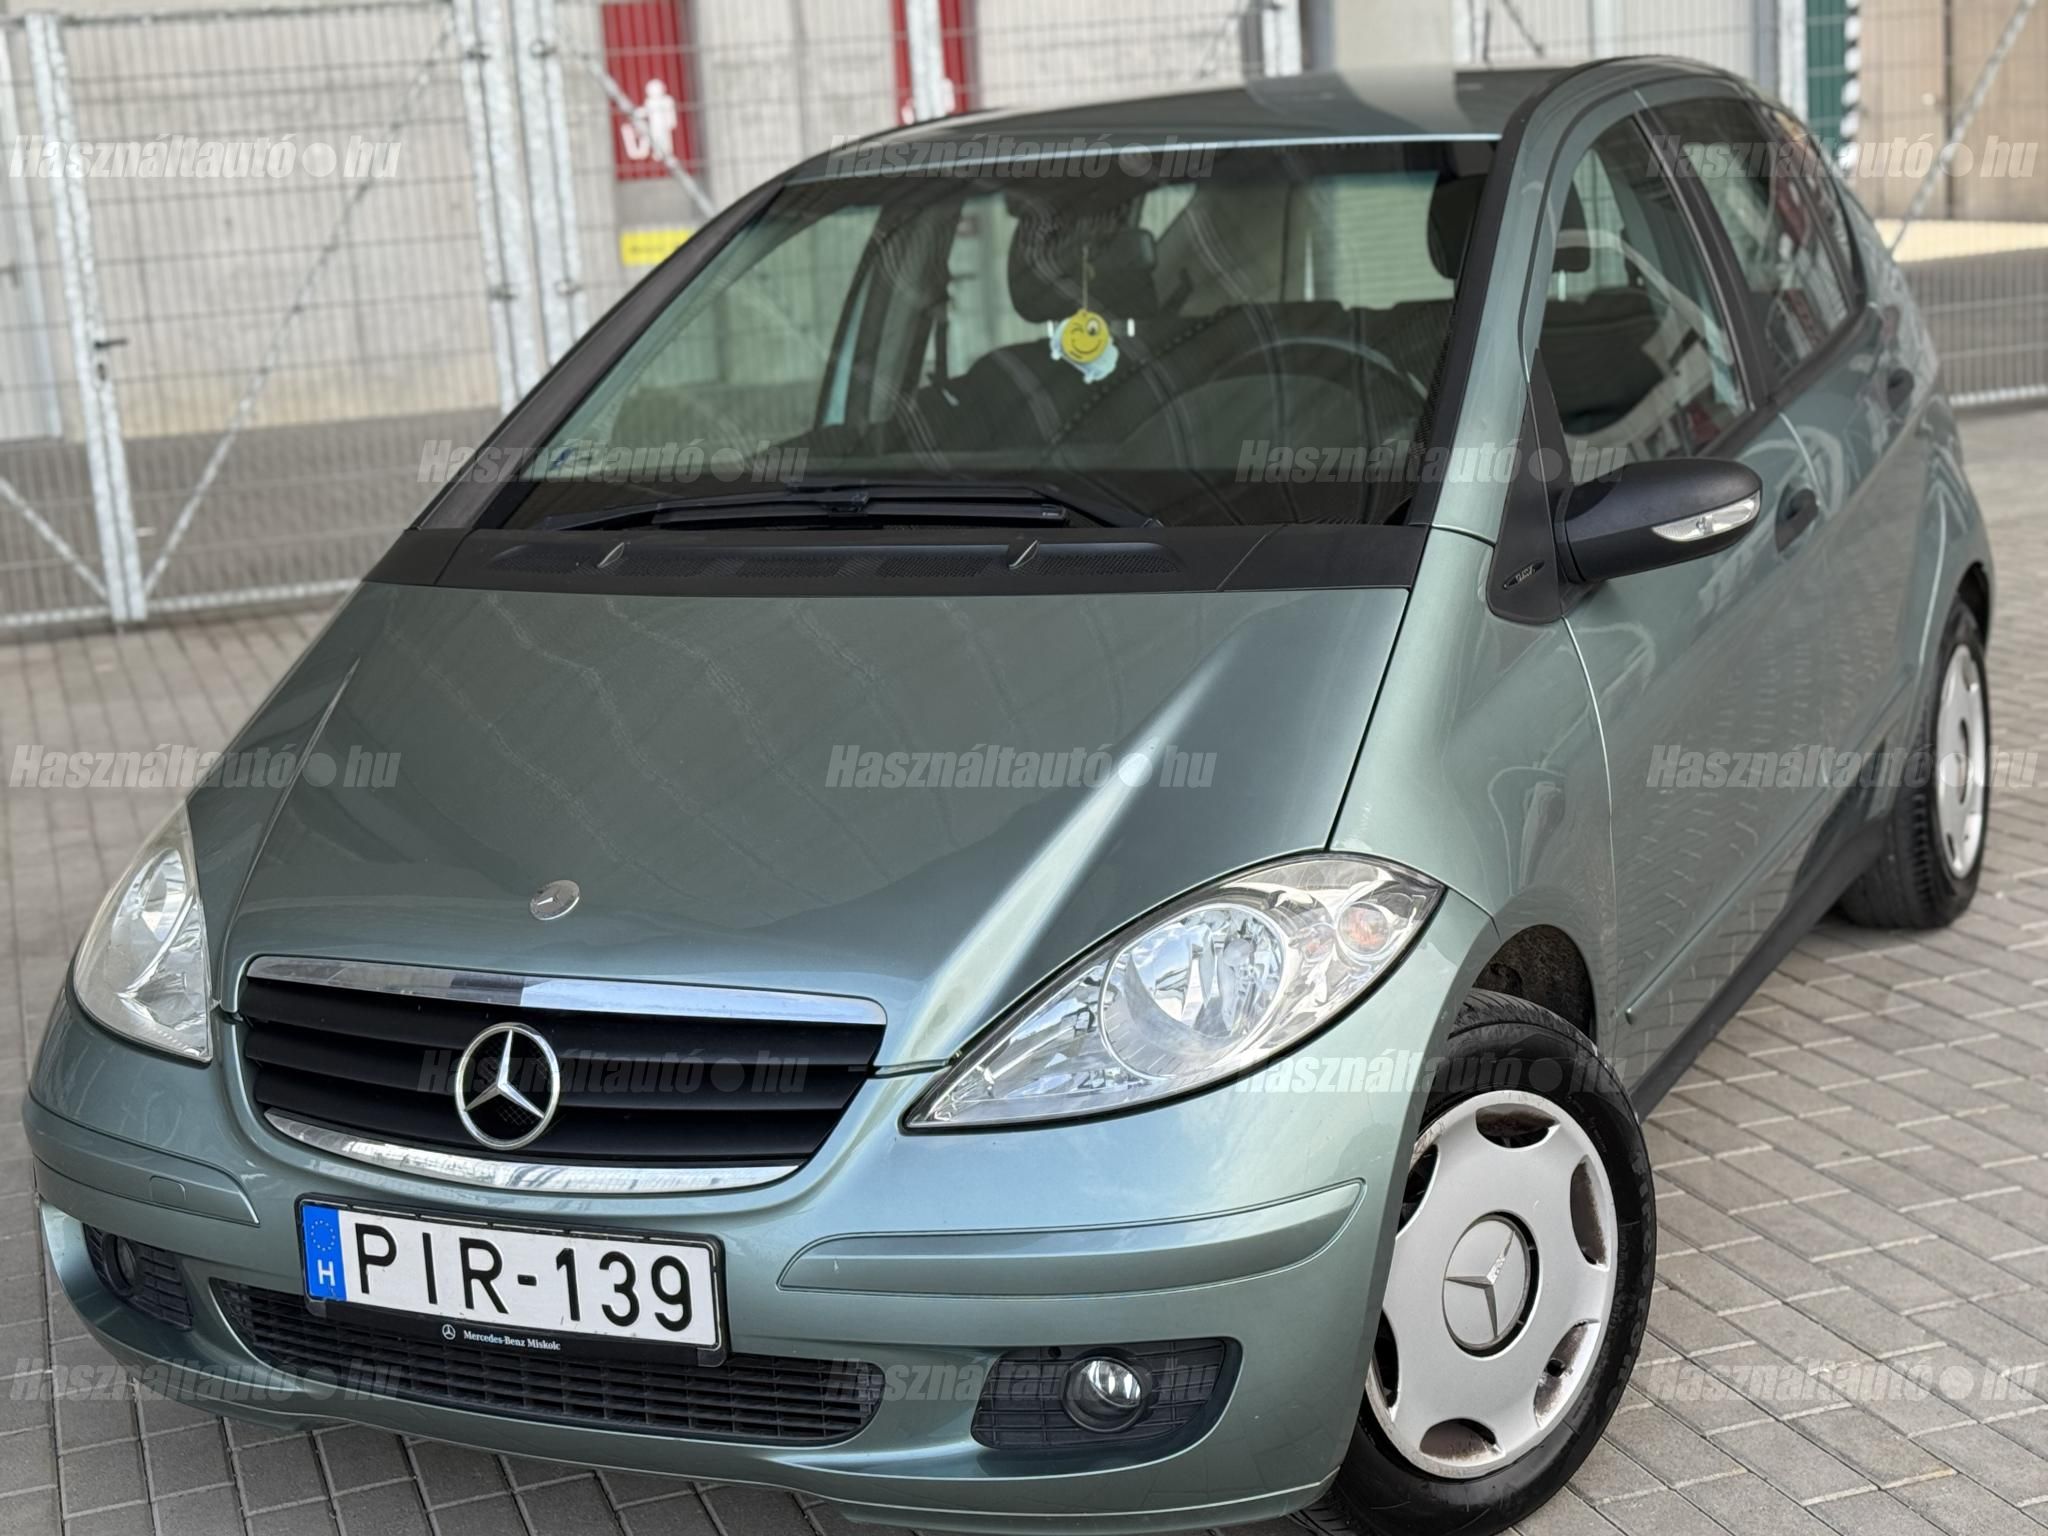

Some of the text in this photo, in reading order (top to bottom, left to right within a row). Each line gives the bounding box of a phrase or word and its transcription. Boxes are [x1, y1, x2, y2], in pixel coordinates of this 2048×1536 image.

[318, 1258, 335, 1287] H
[354, 1222, 693, 1333] PIR-139
[463, 1329, 561, 1351] Mercedes-Benz Miskolc
